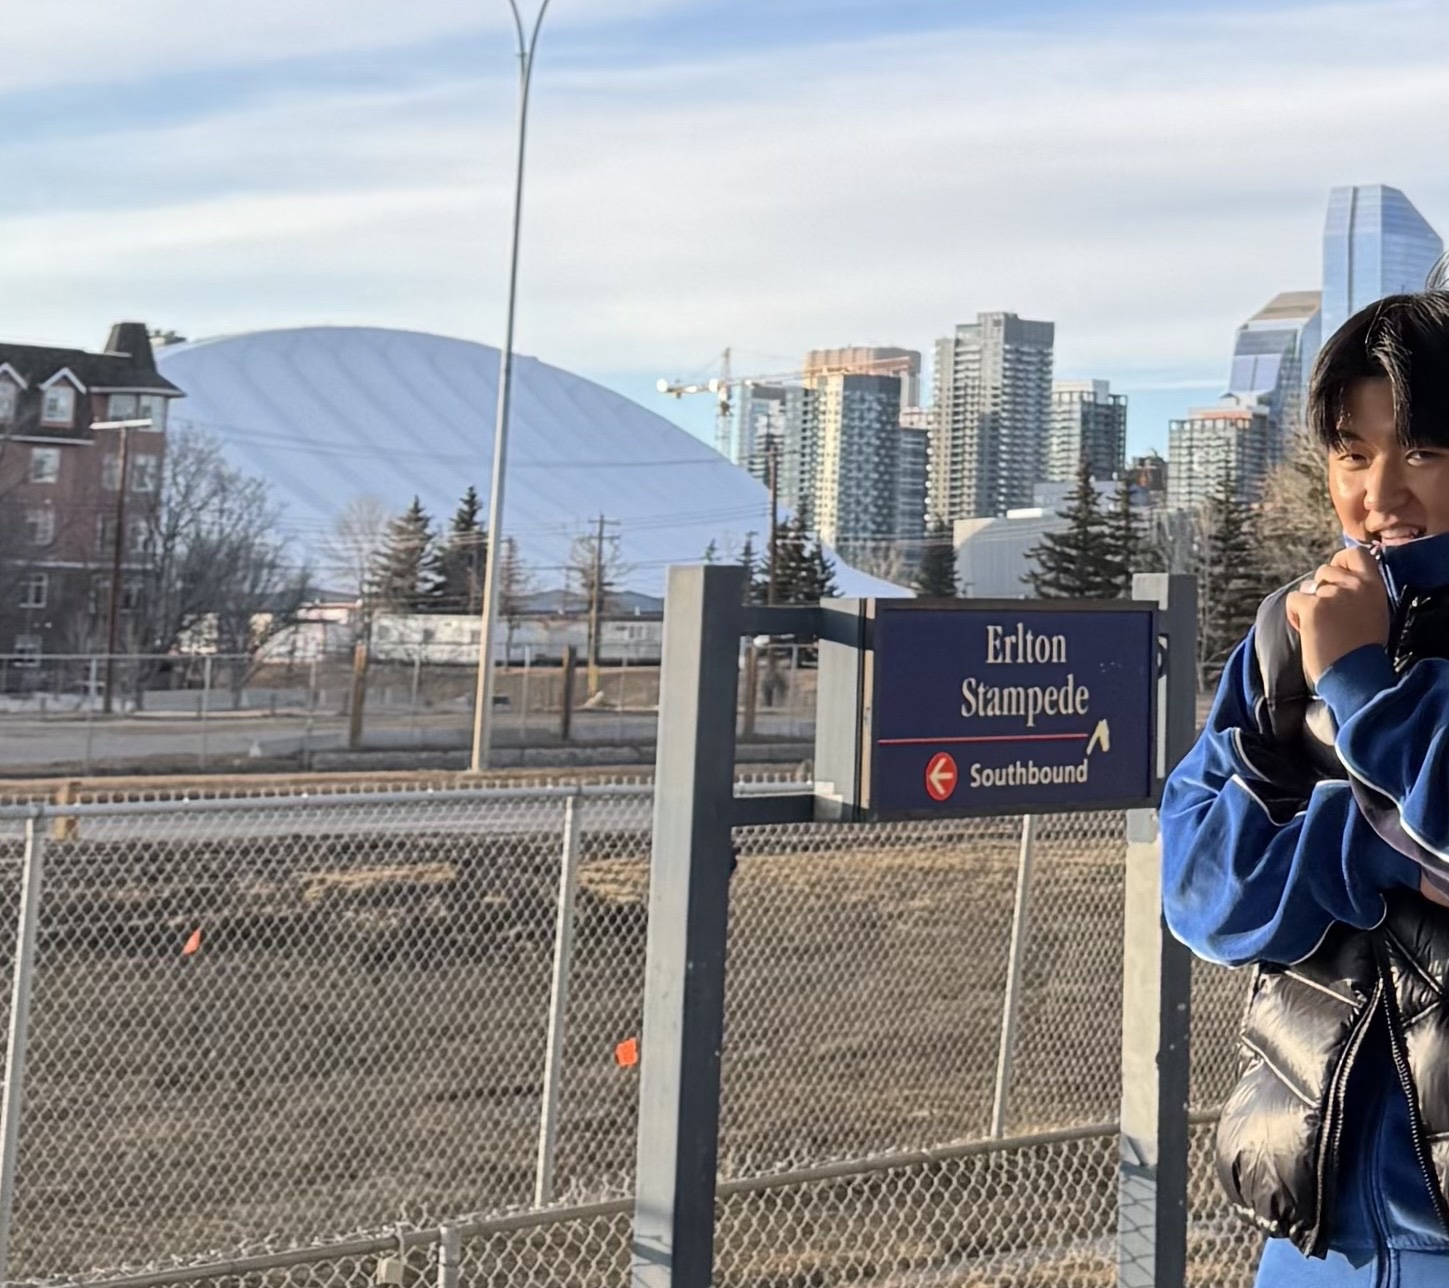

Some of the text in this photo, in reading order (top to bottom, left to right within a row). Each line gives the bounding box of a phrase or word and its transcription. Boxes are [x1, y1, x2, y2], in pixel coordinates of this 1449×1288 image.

[985, 622, 1067, 664] Erlton
[961, 673, 1089, 727] Stampede
[970, 758, 1088, 788] Southbound
